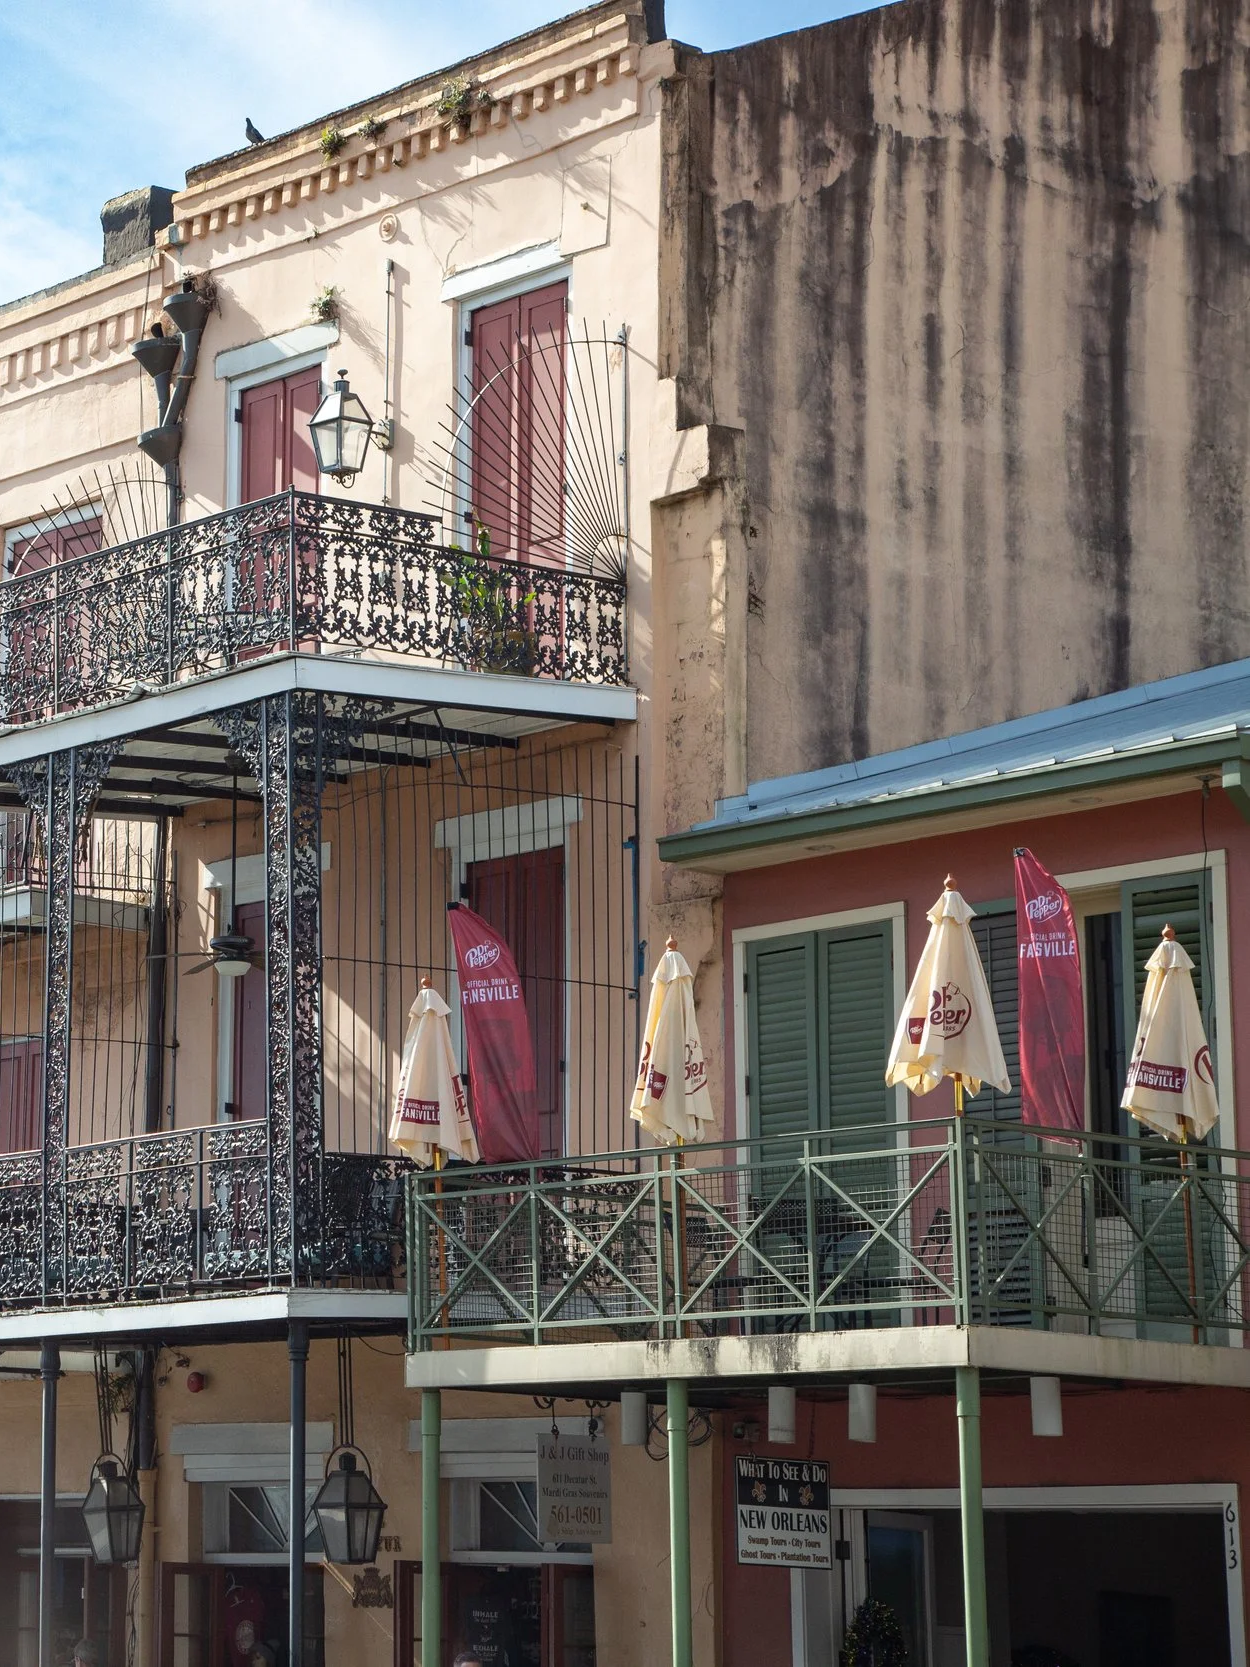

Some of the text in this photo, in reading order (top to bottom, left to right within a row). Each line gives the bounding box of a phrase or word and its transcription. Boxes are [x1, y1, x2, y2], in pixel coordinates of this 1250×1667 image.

[1038, 895, 1052, 908] Dr
[1029, 899, 1060, 920] Pepper
[1050, 931, 1066, 940] DRINK
[476, 944, 489, 956] Dr
[469, 947, 498, 968] Pepper
[467, 977, 509, 989] OFFICIAL DRINK
[1157, 1067, 1173, 1076] DRINK
[1137, 1071, 1181, 1089] ANSVILLE
[540, 1445, 610, 1465] J & J Gift Shop
[564, 1474, 589, 1484] Decatur
[801, 1464, 810, 1482] &
[542, 1487, 608, 1499] Mardi Gras Souvenirs
[551, 1504, 603, 1525] 561-0501
[739, 1509, 828, 1534] NEW ORLEANS
[747, 1535, 821, 1549] Swamp Tours City Tours
[740, 1549, 829, 1563] Ghost Tours Plantation Tours
